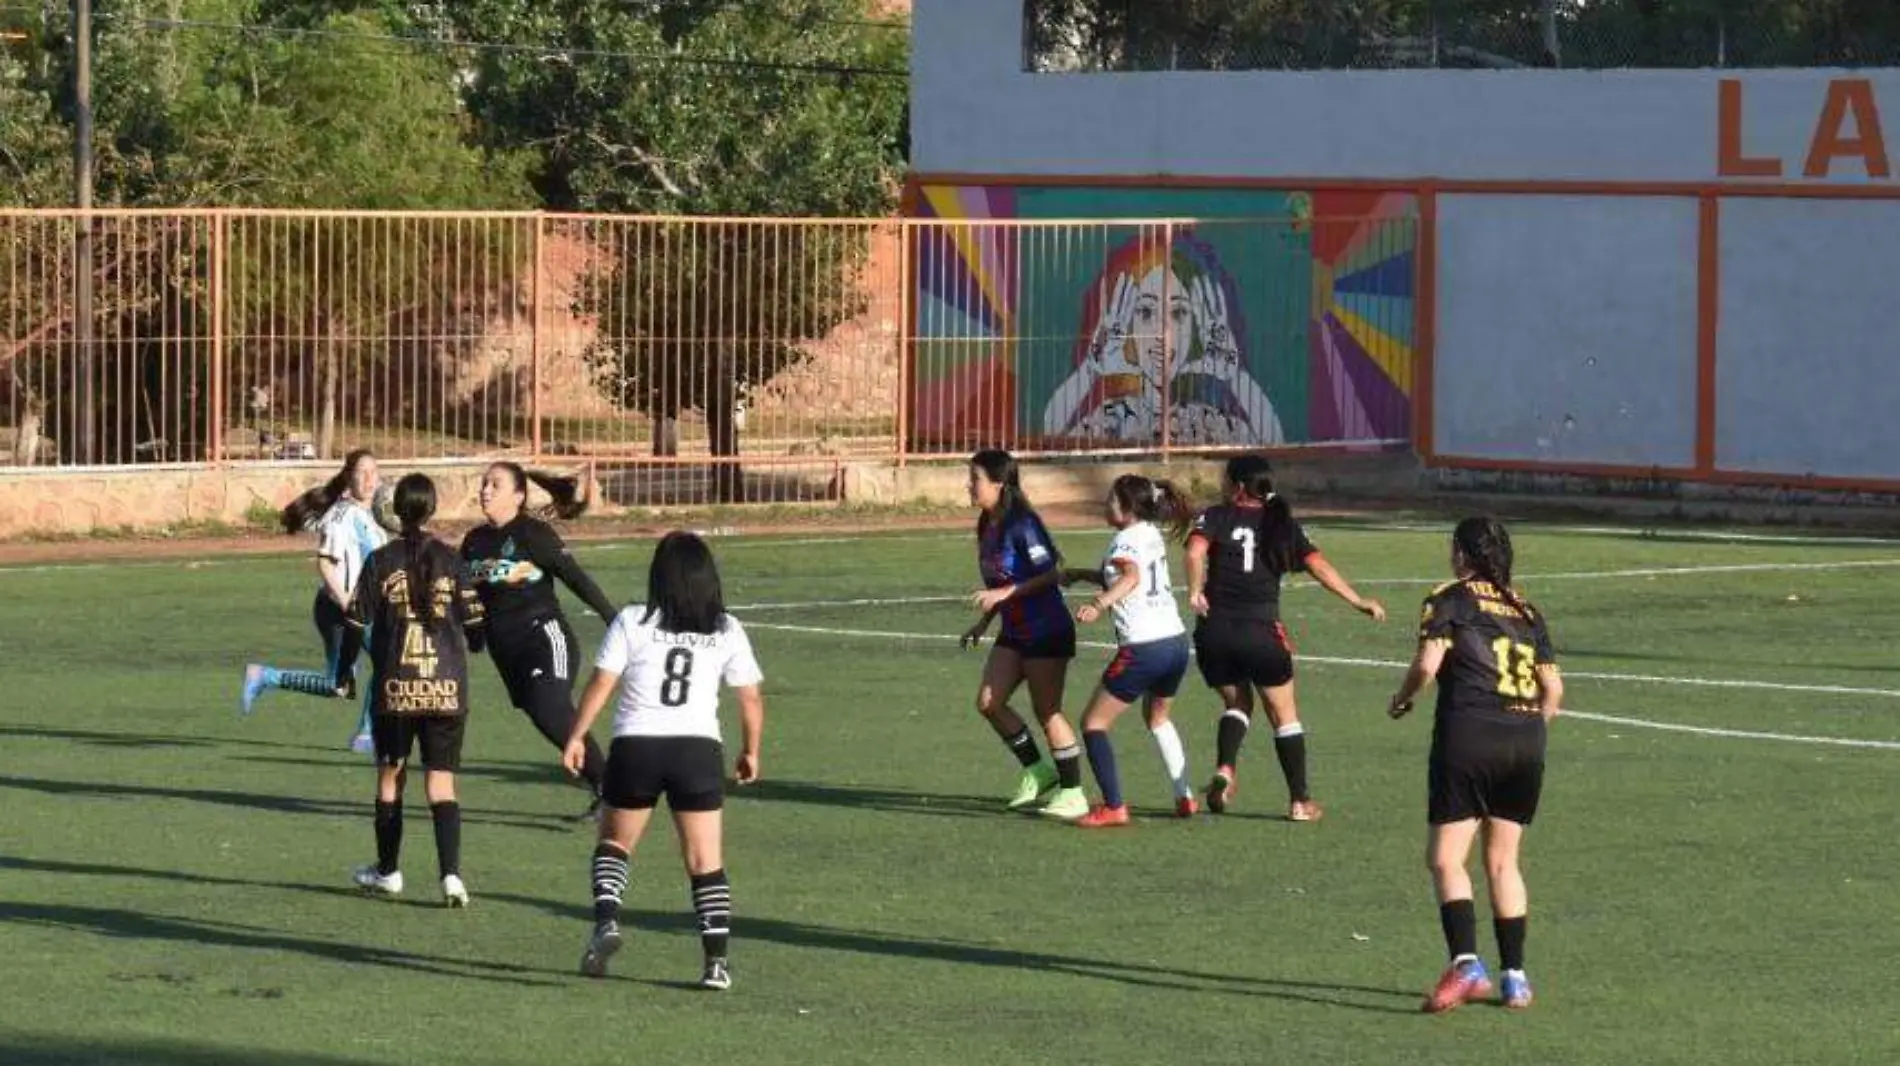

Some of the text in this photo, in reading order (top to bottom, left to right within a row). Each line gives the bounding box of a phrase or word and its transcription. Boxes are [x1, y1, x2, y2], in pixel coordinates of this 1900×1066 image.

[1718, 79, 1891, 176] LA
[402, 621, 438, 678] 4
[660, 646, 693, 707] 8
[386, 679, 458, 696] CIUDAD
